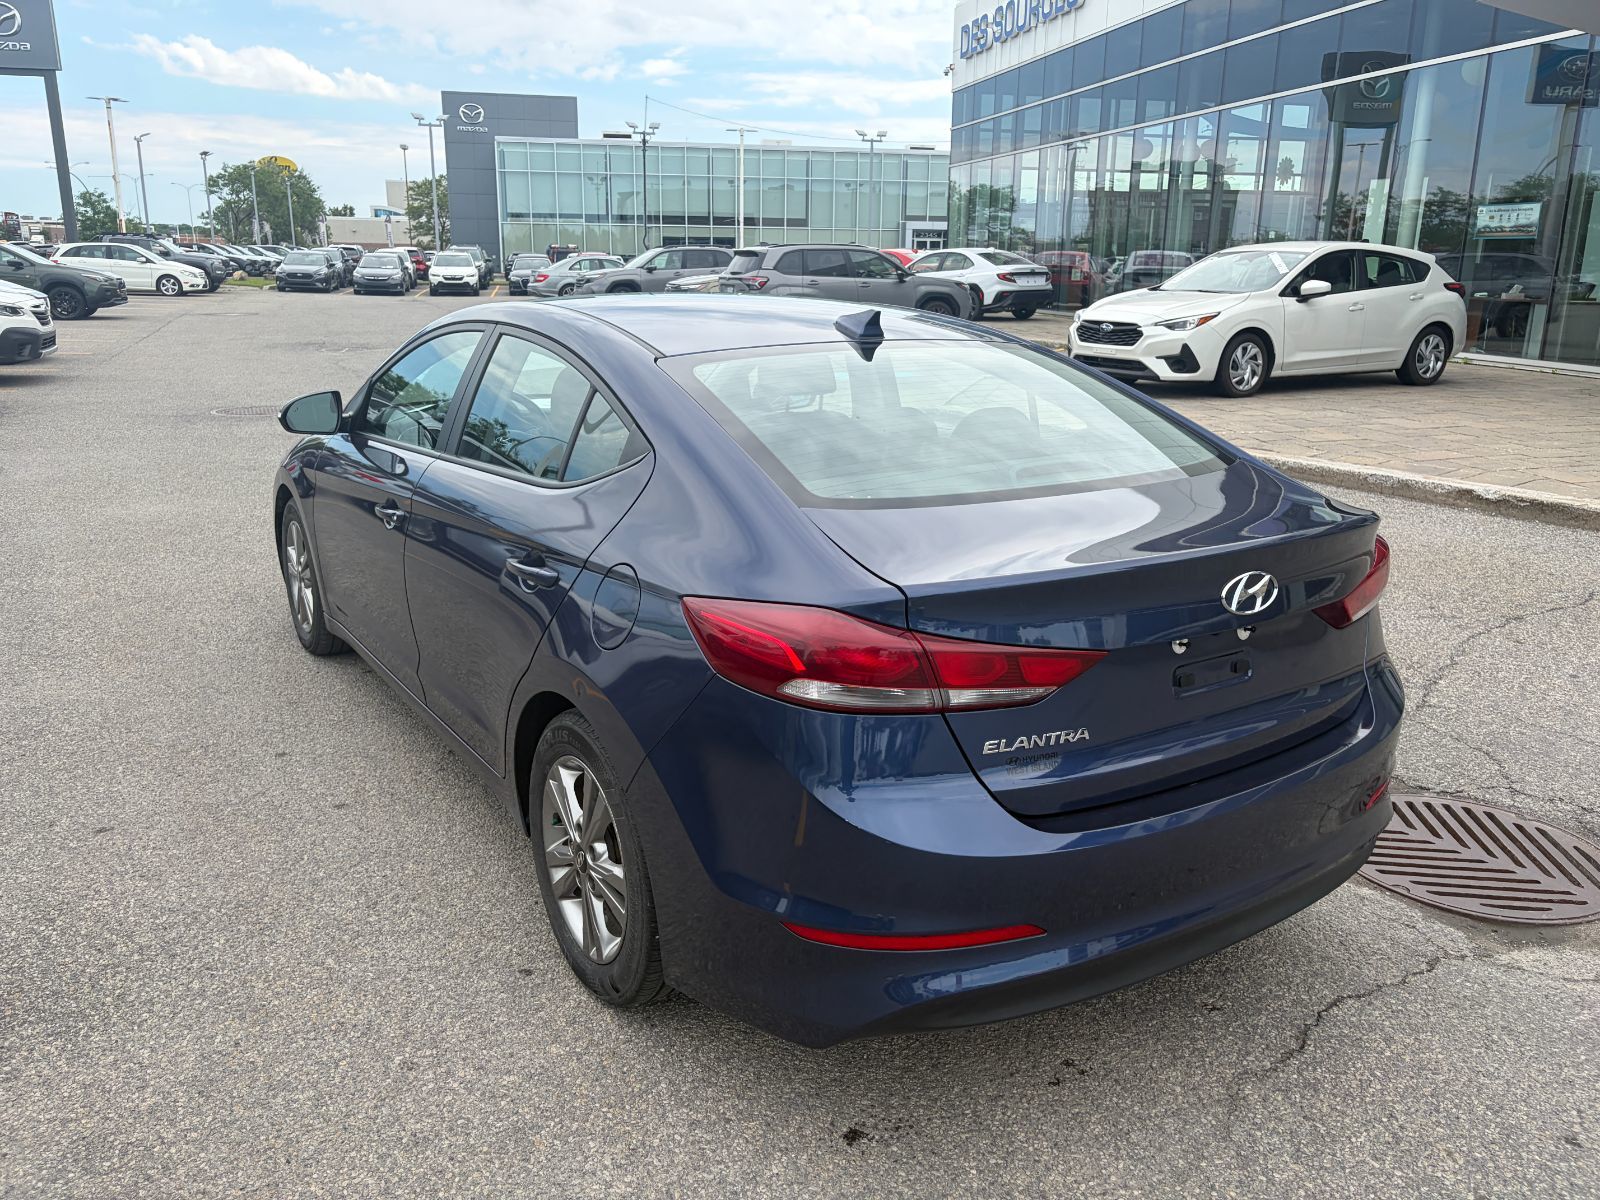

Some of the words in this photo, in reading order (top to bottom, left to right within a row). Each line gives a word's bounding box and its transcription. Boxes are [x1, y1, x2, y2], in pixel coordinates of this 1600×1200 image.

[960, 13, 990, 59] DES
[992, 0, 1081, 43] SOURC
[983, 727, 1090, 755] ELANTRA
